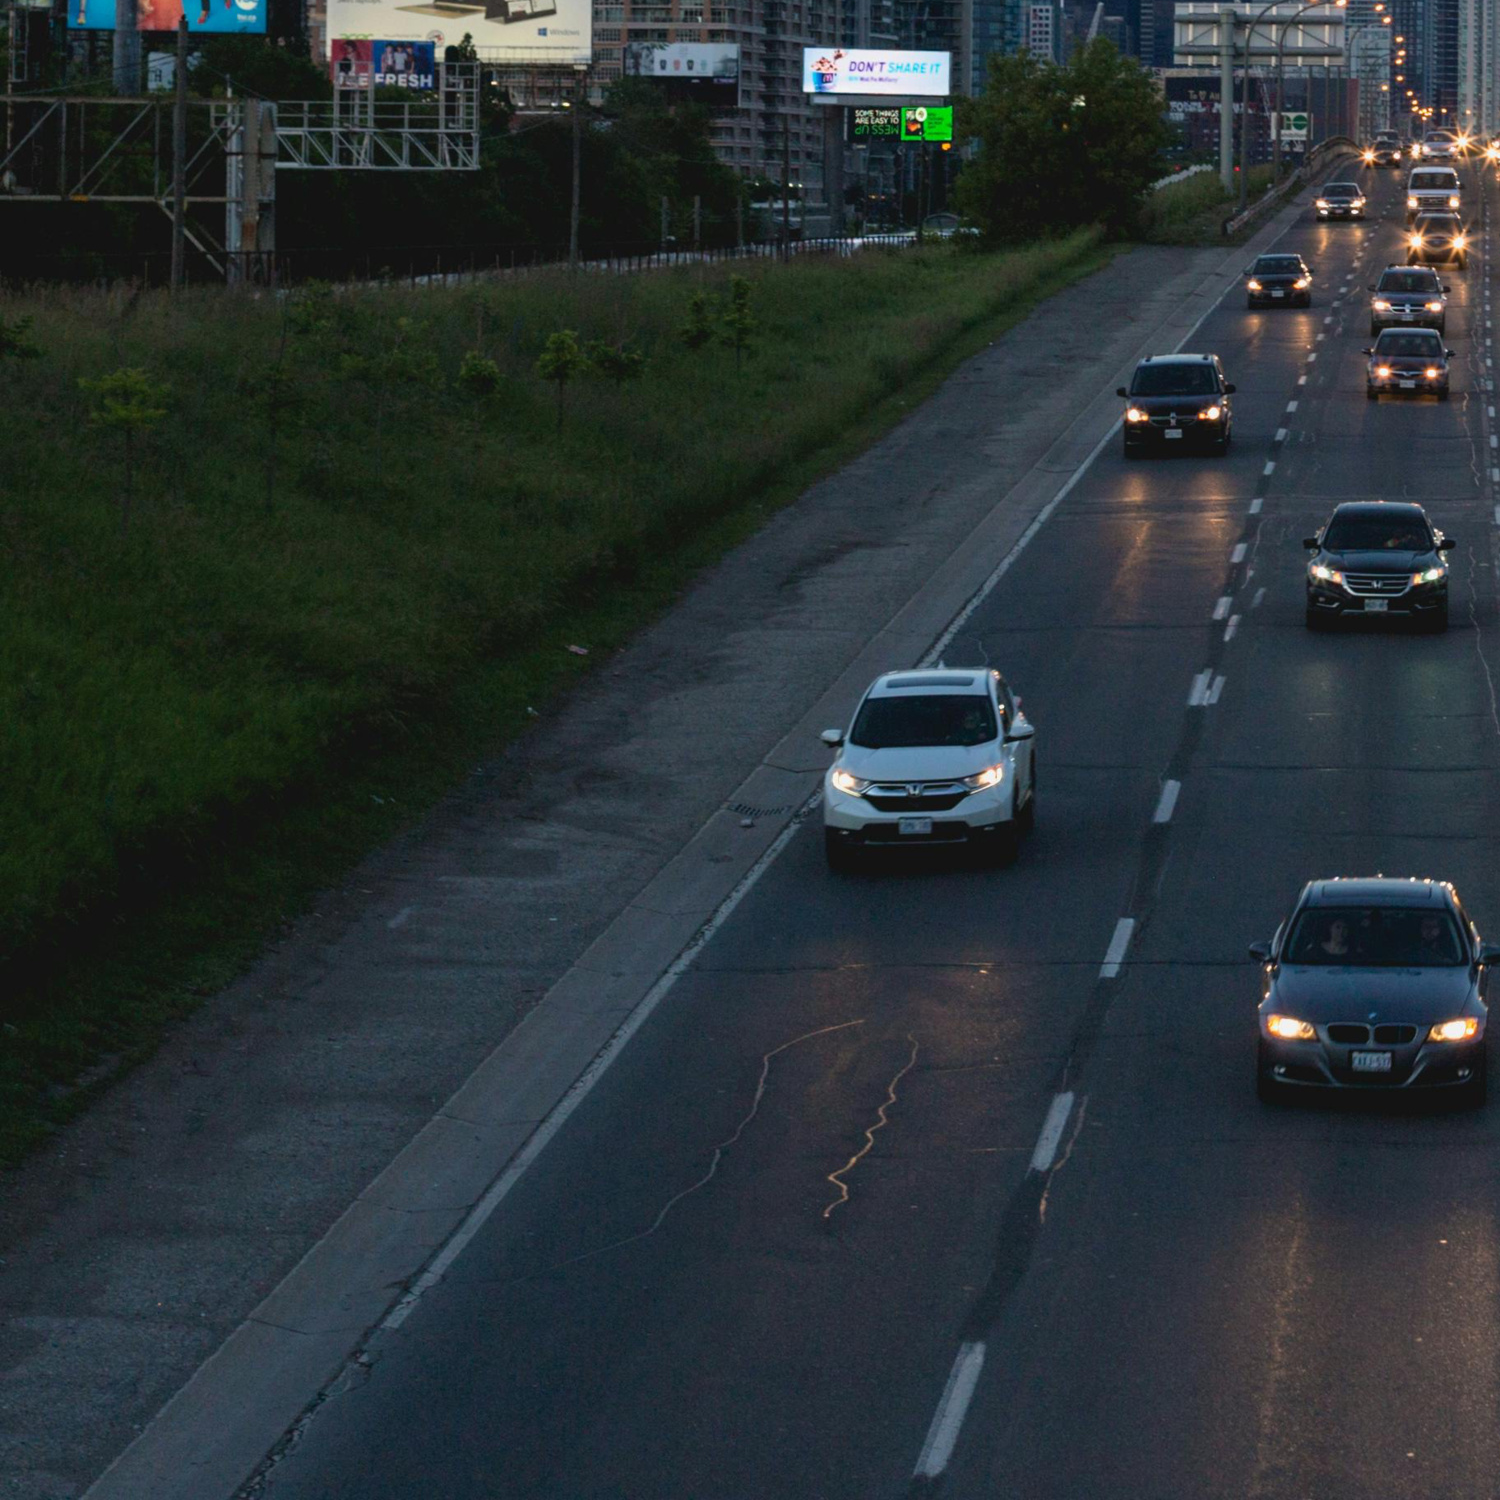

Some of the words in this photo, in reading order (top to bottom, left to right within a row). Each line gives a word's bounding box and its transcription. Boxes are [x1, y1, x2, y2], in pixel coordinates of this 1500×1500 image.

[849, 61, 886, 73] DON'T
[888, 62, 928, 74] SHARE
[929, 63, 942, 74] IT
[374, 72, 432, 88] FRESH
[854, 109, 875, 117] SOME
[875, 109, 899, 118] THINGS
[854, 117, 869, 125] ARE
[870, 117, 888, 125] EASY
